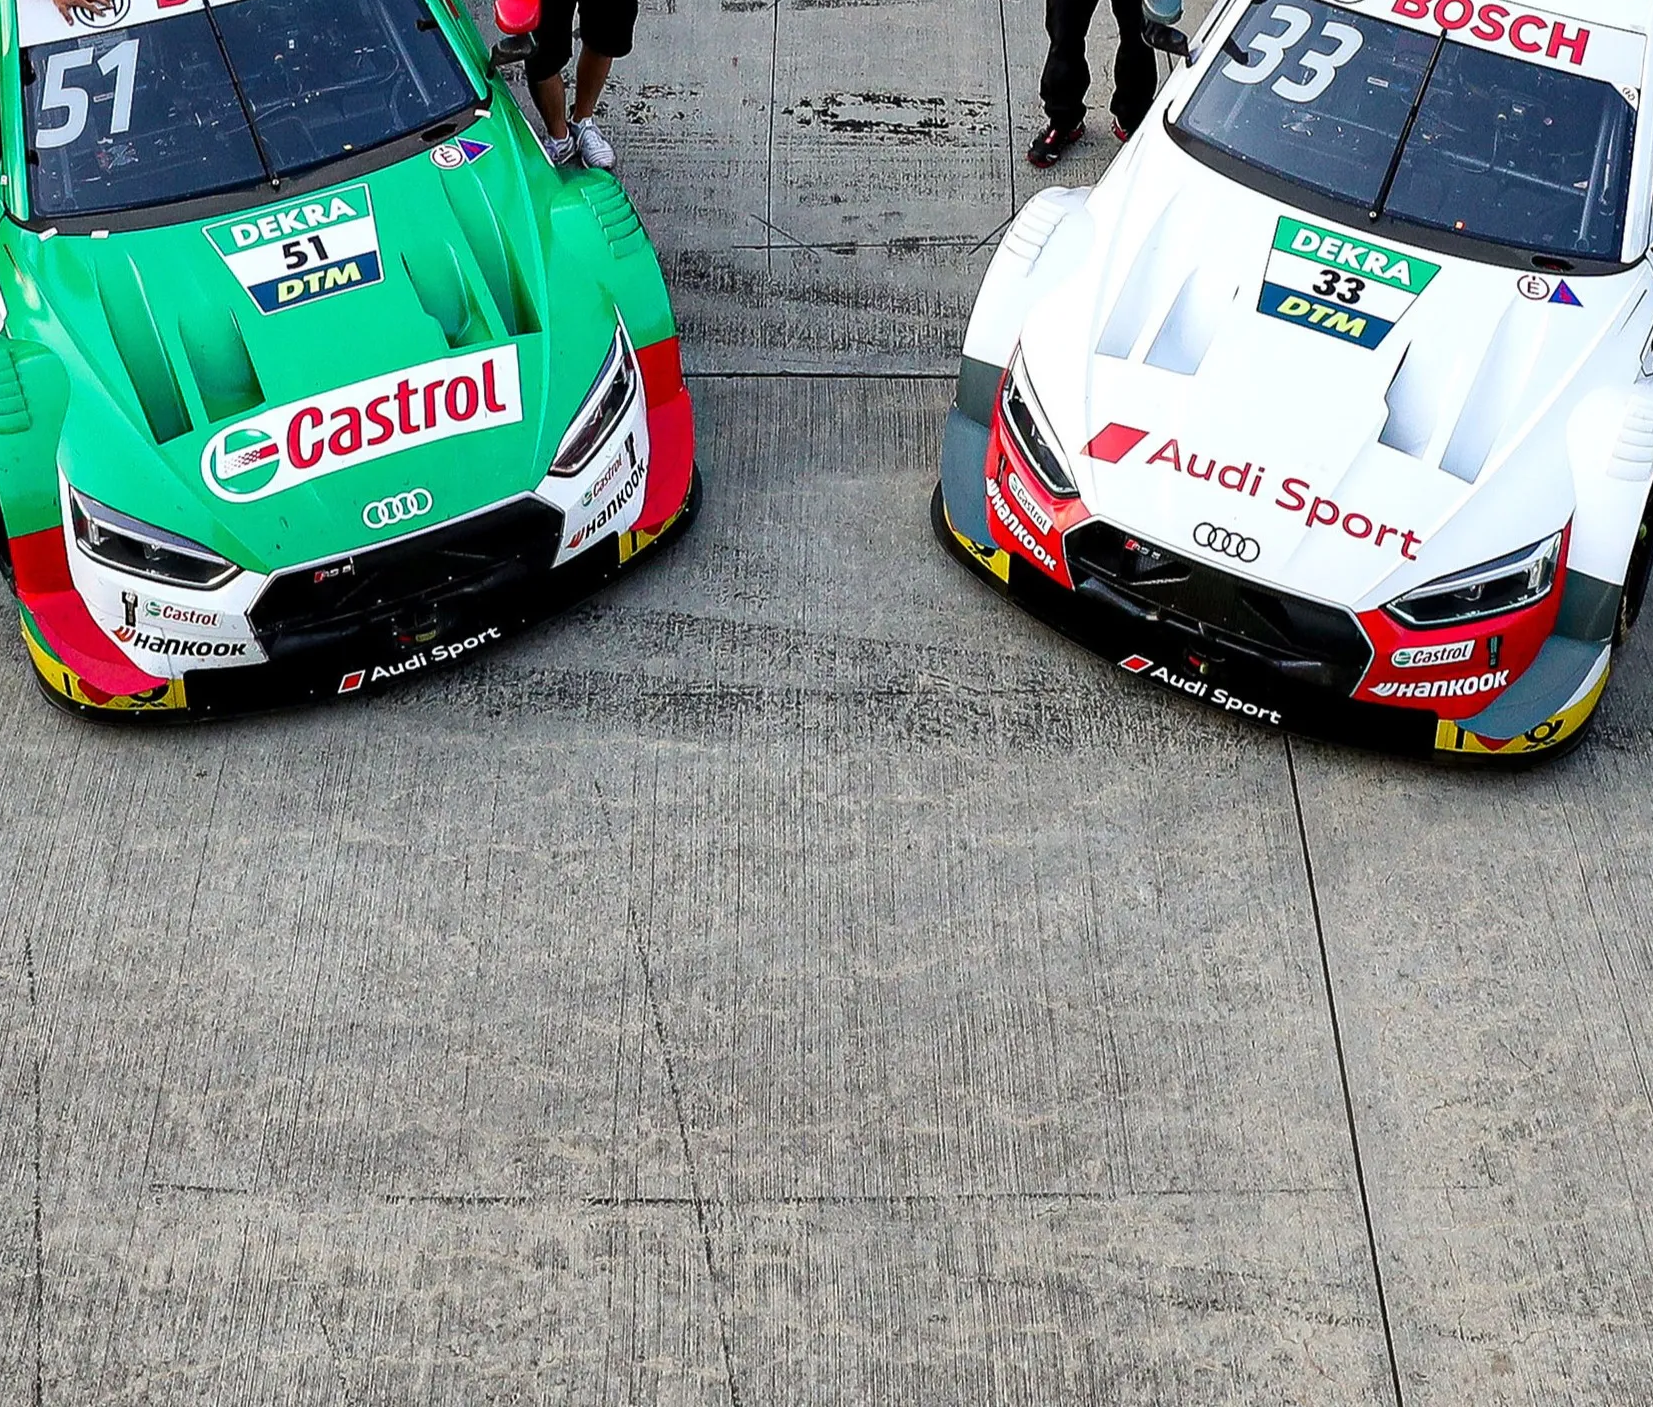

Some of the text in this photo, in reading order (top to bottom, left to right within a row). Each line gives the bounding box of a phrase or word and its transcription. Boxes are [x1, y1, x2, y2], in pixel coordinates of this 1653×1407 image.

[1224, 3, 1364, 103] 33
[36, 38, 140, 149] 51
[229, 197, 357, 249] DEKRA
[283, 235, 331, 271] 51
[1290, 226, 1413, 287] DEKRA
[276, 259, 363, 302] DTM
[1313, 269, 1365, 305] 33
[1276, 293, 1367, 338] DTM
[286, 360, 506, 469] Castrol
[591, 455, 623, 494] Castrol
[1148, 437, 1421, 562] Audi Sport
[1012, 482, 1052, 534] Castrol
[160, 603, 219, 628] Castrol
[370, 625, 502, 683] Audi Sport
[1410, 642, 1471, 665] Castrol
[1150, 664, 1282, 725] Audi Sport
